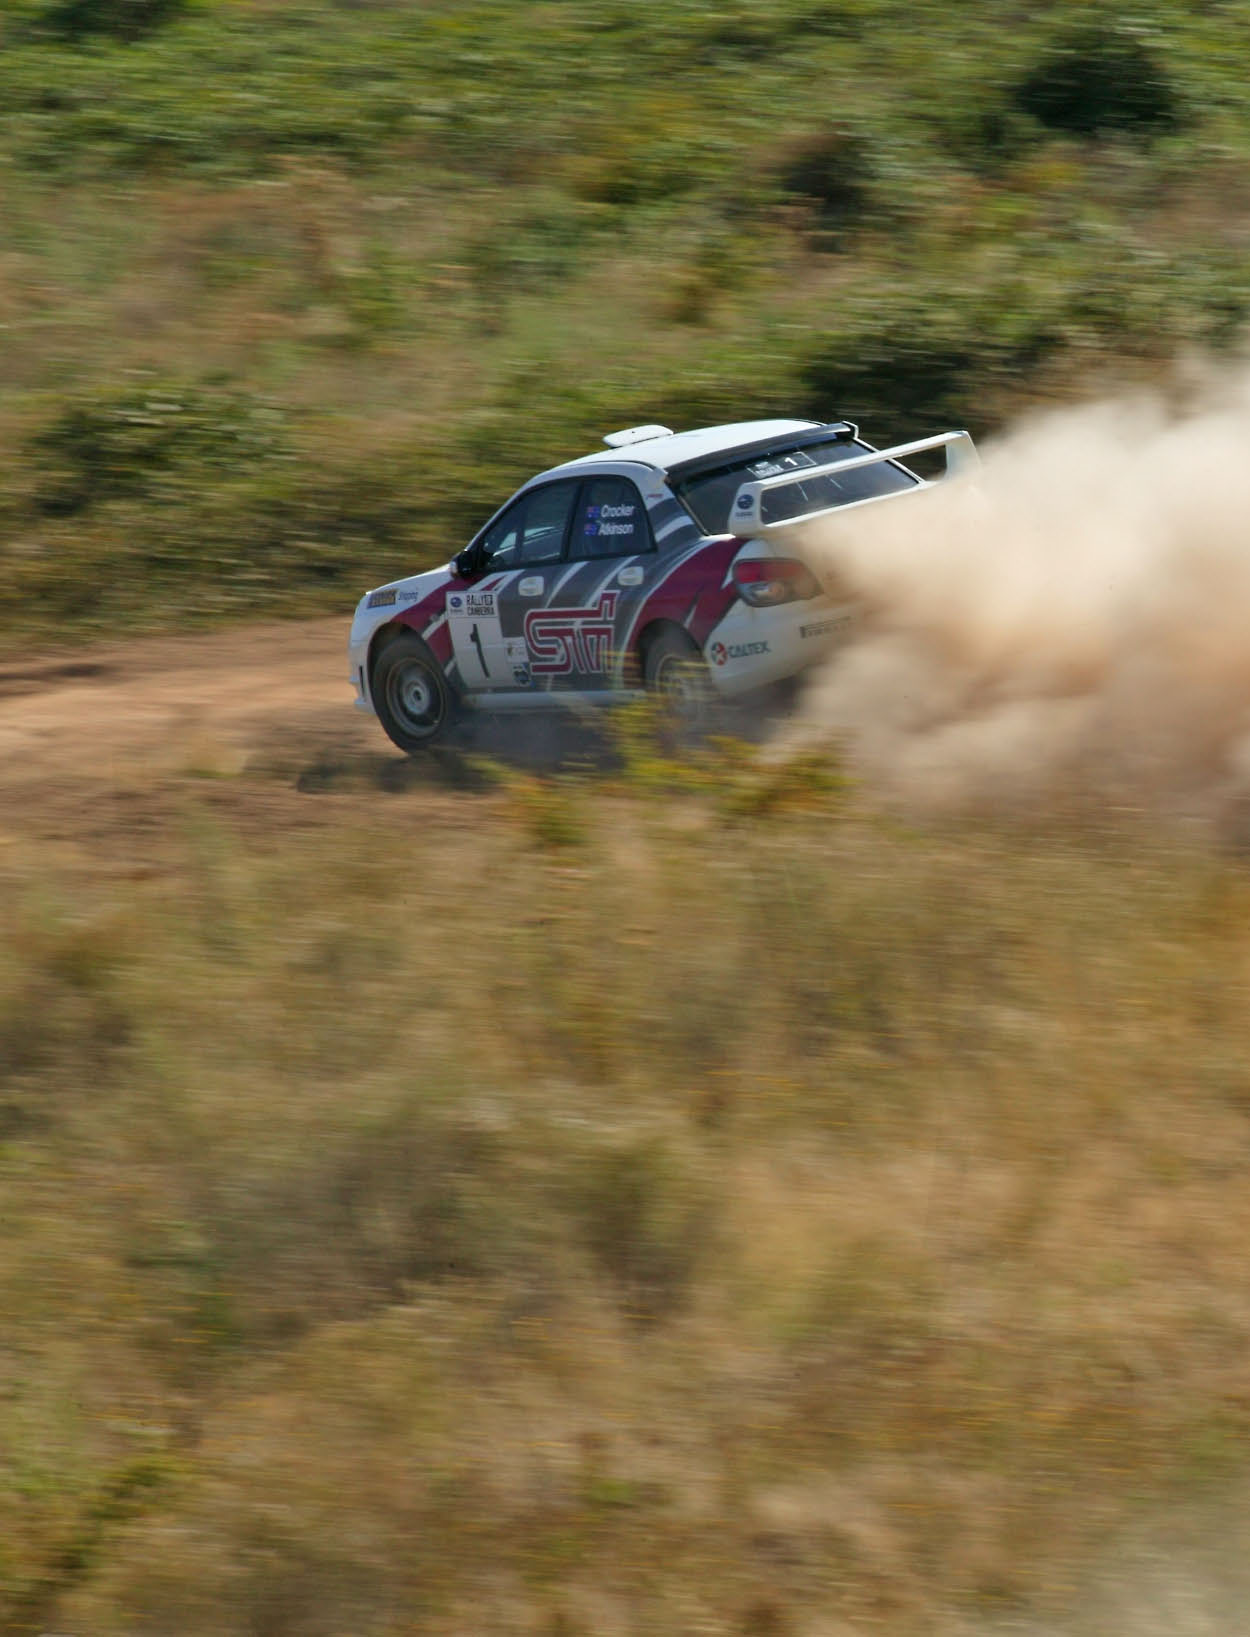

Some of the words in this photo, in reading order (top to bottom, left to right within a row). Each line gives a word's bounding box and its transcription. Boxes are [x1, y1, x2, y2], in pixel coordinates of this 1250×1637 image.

[785, 457, 799, 466] 1
[601, 504, 634, 517] Crocker
[598, 523, 634, 536] Atkinson
[467, 595, 484, 606] RALLY
[470, 624, 490, 678] 1
[728, 640, 772, 658] CALTEX
